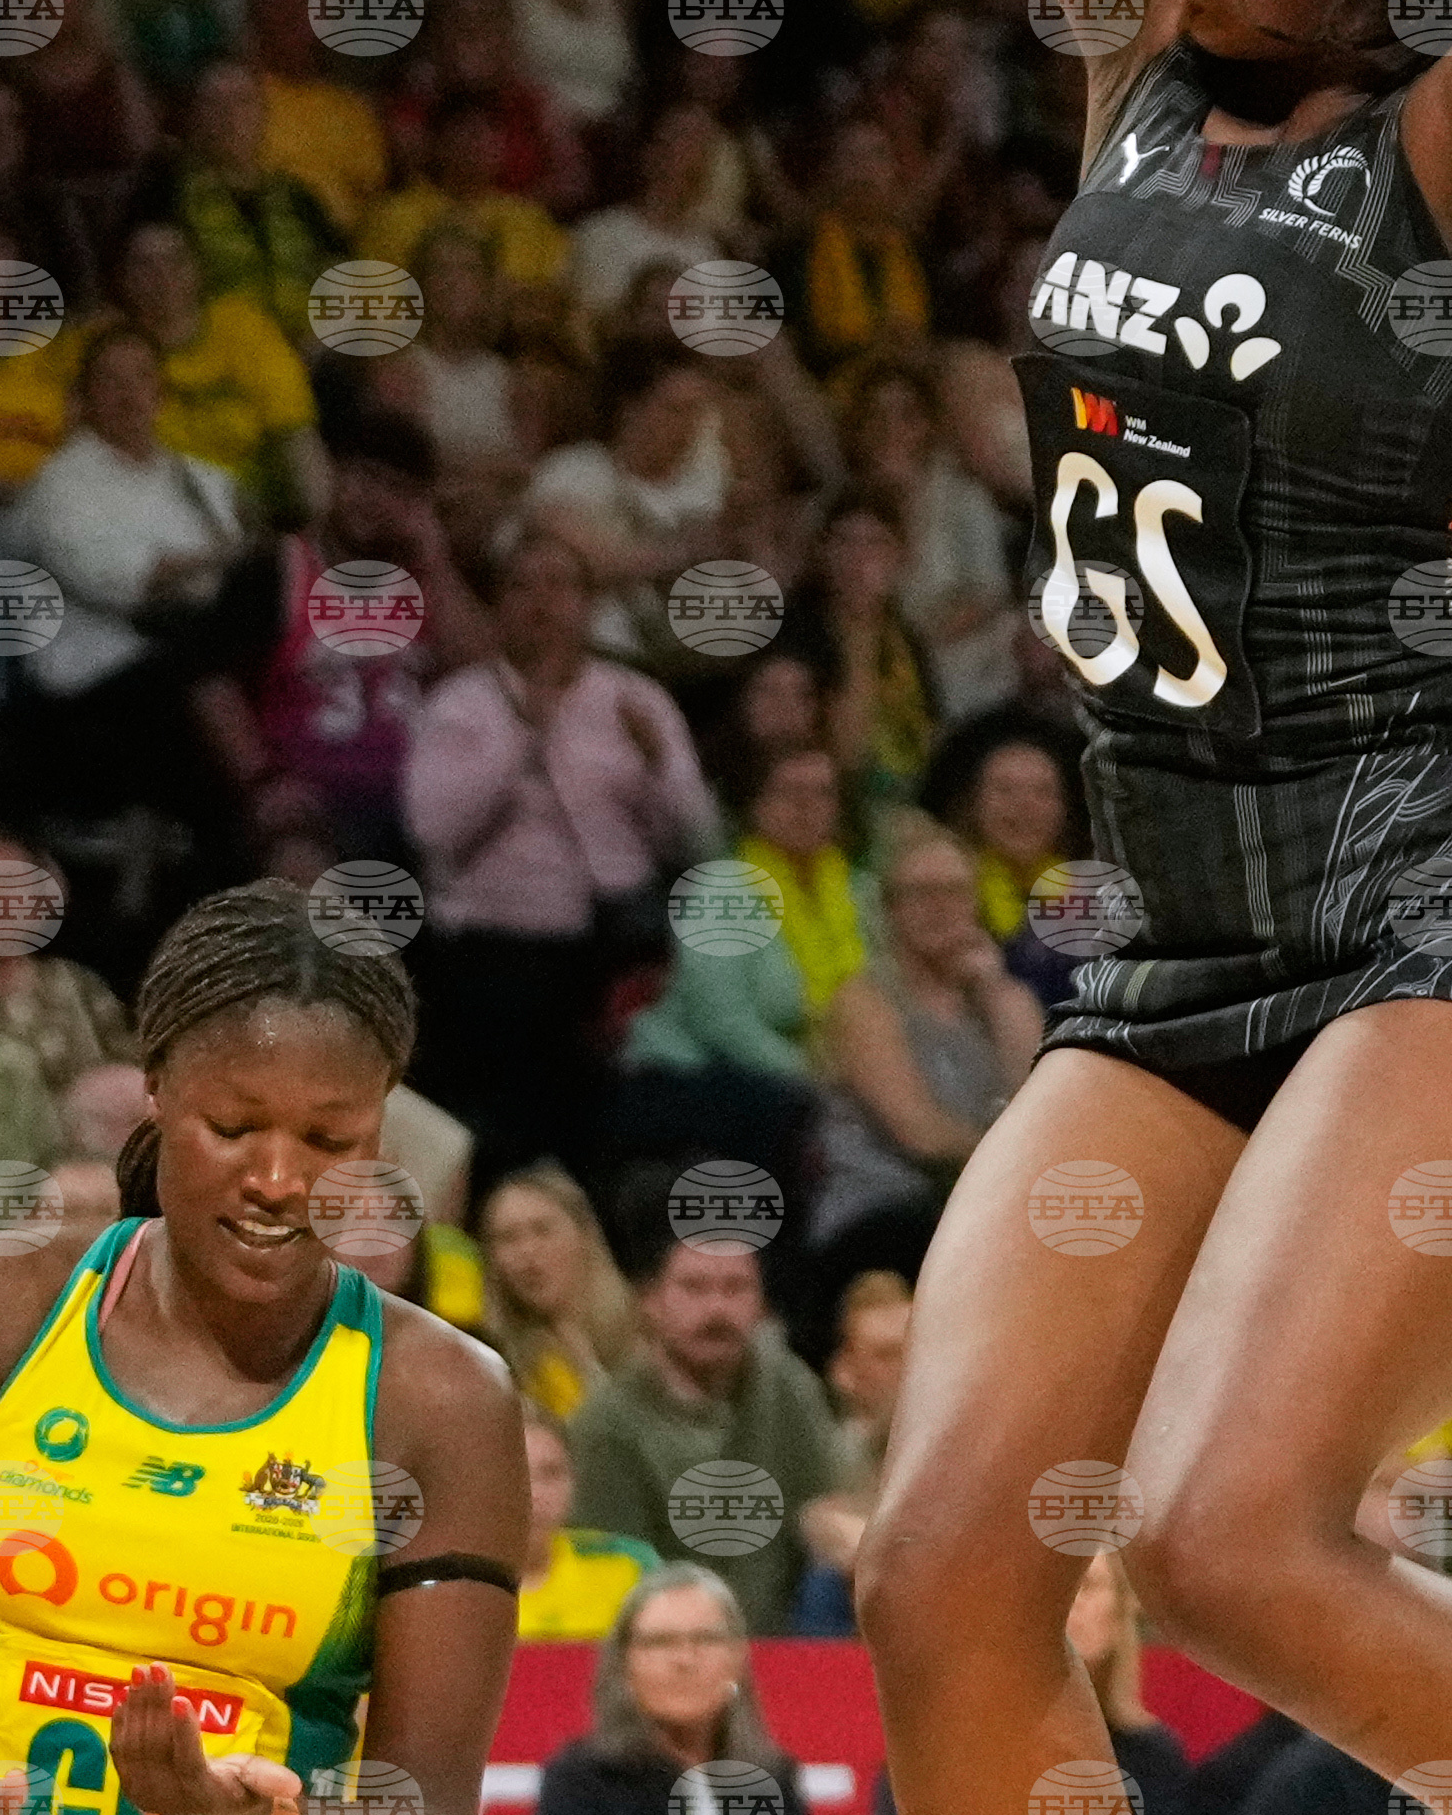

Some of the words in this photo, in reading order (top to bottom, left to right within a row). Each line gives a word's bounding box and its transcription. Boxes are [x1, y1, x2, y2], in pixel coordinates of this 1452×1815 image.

[1258, 207, 1308, 229] SILVER
[1308, 219, 1363, 249] FERNS
[1031, 250, 1181, 355] ANZ
[1123, 428, 1148, 446] New
[1146, 434, 1192, 459] Zealand
[1041, 450, 1228, 708] GS
[99, 1572, 298, 1647] origin
[29, 1670, 232, 1727] NISN
